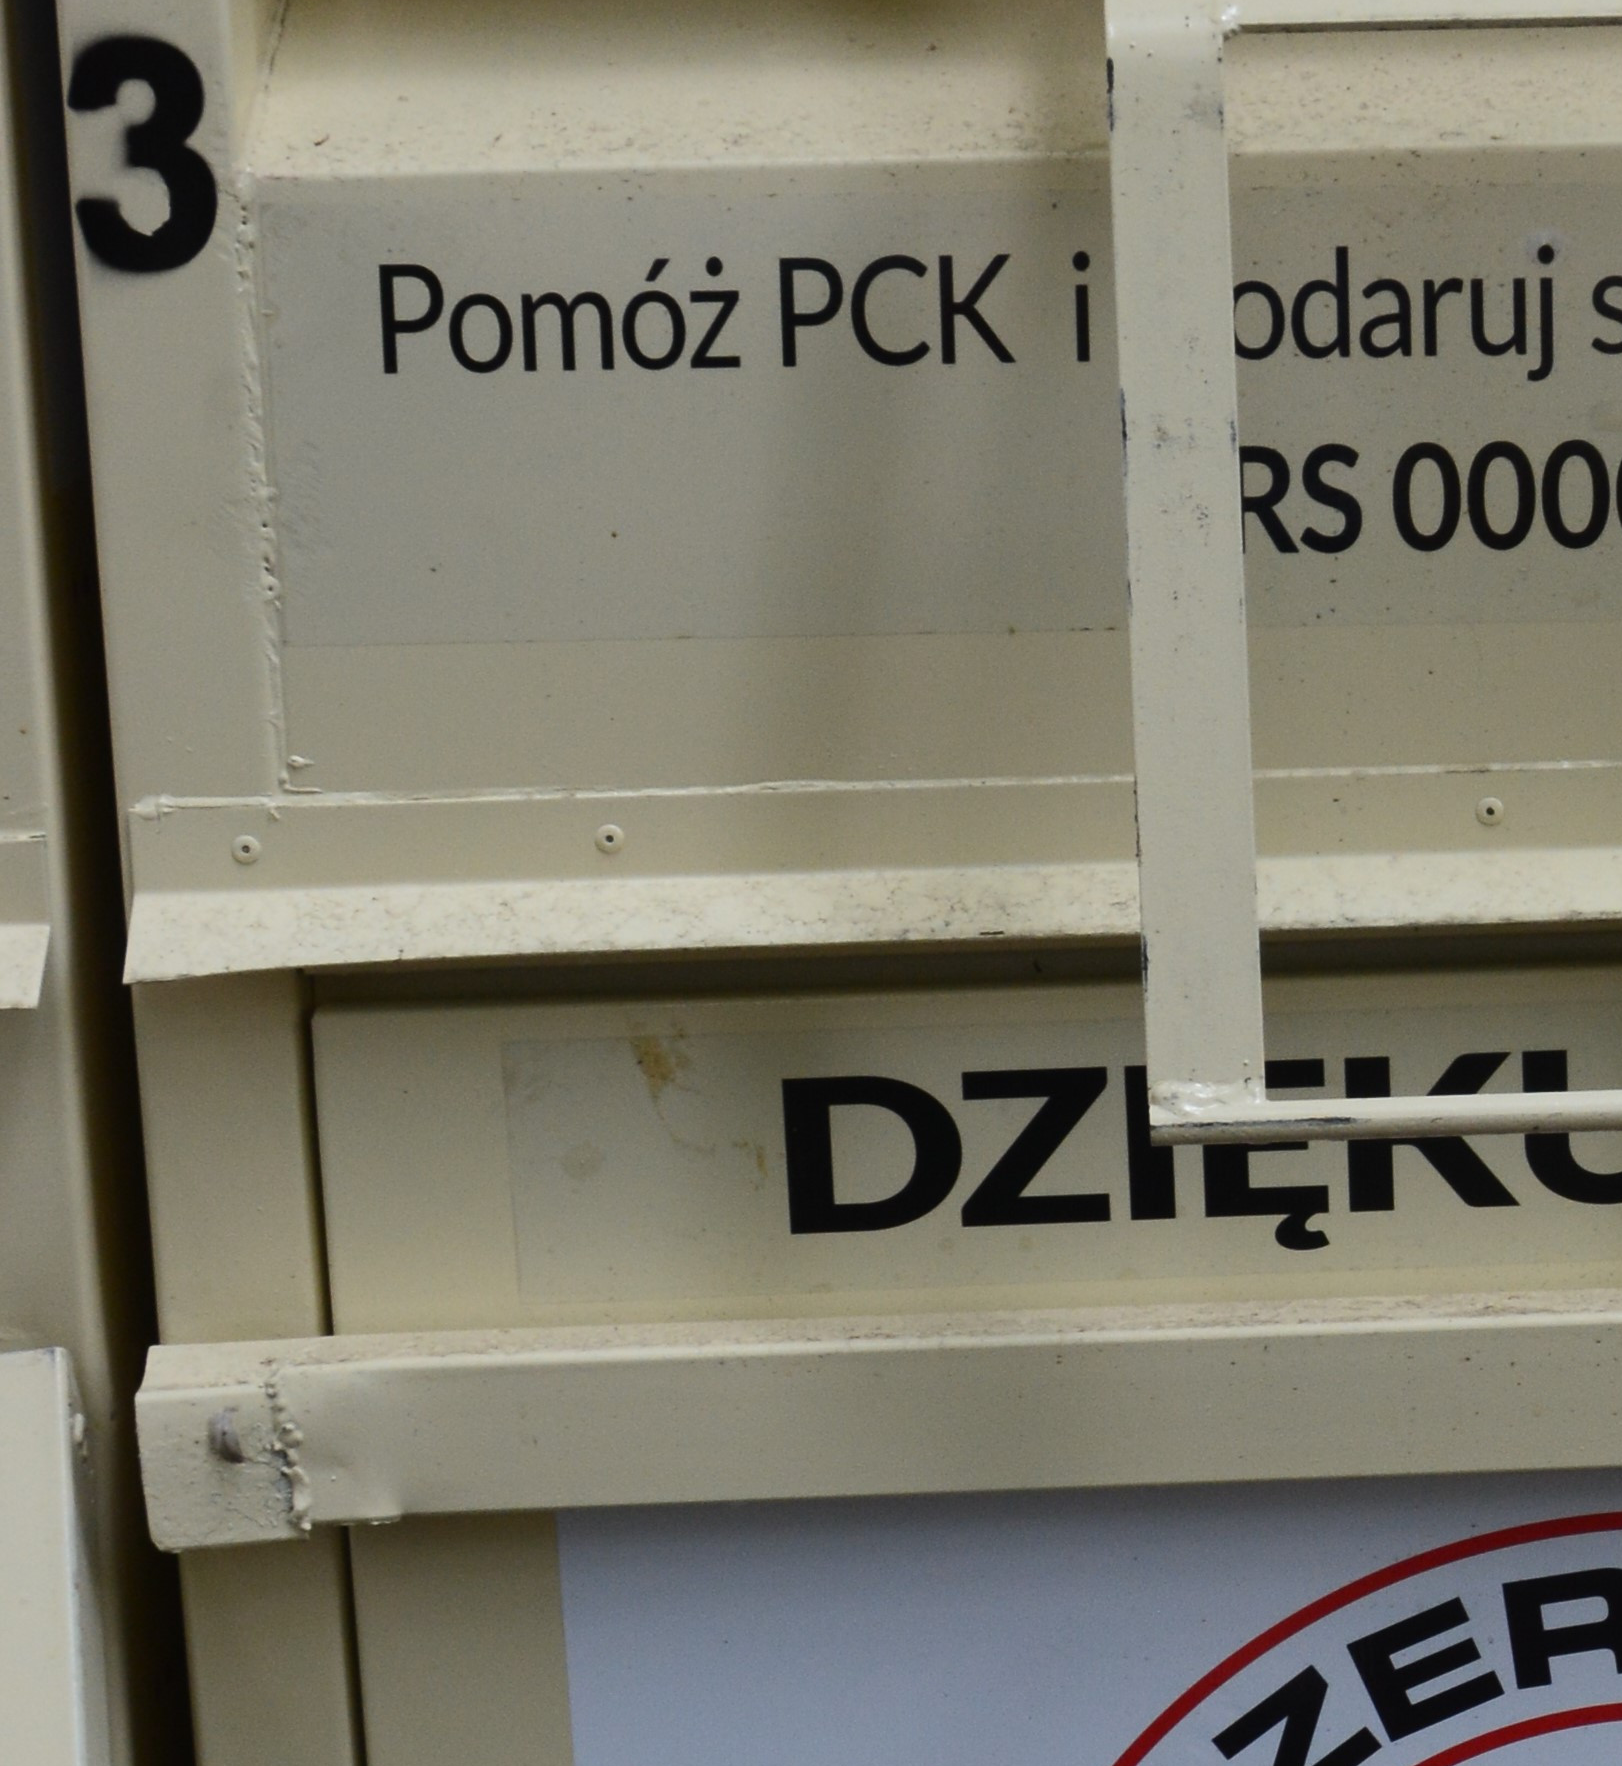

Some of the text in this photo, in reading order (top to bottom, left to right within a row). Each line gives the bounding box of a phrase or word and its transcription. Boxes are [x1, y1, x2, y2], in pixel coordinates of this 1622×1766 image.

[379, 257, 740, 374] Pomóż
[780, 254, 1015, 367] PCK
[1072, 251, 1090, 362] i
[1234, 245, 1555, 381] odaruj
[1242, 444, 1362, 553] RS
